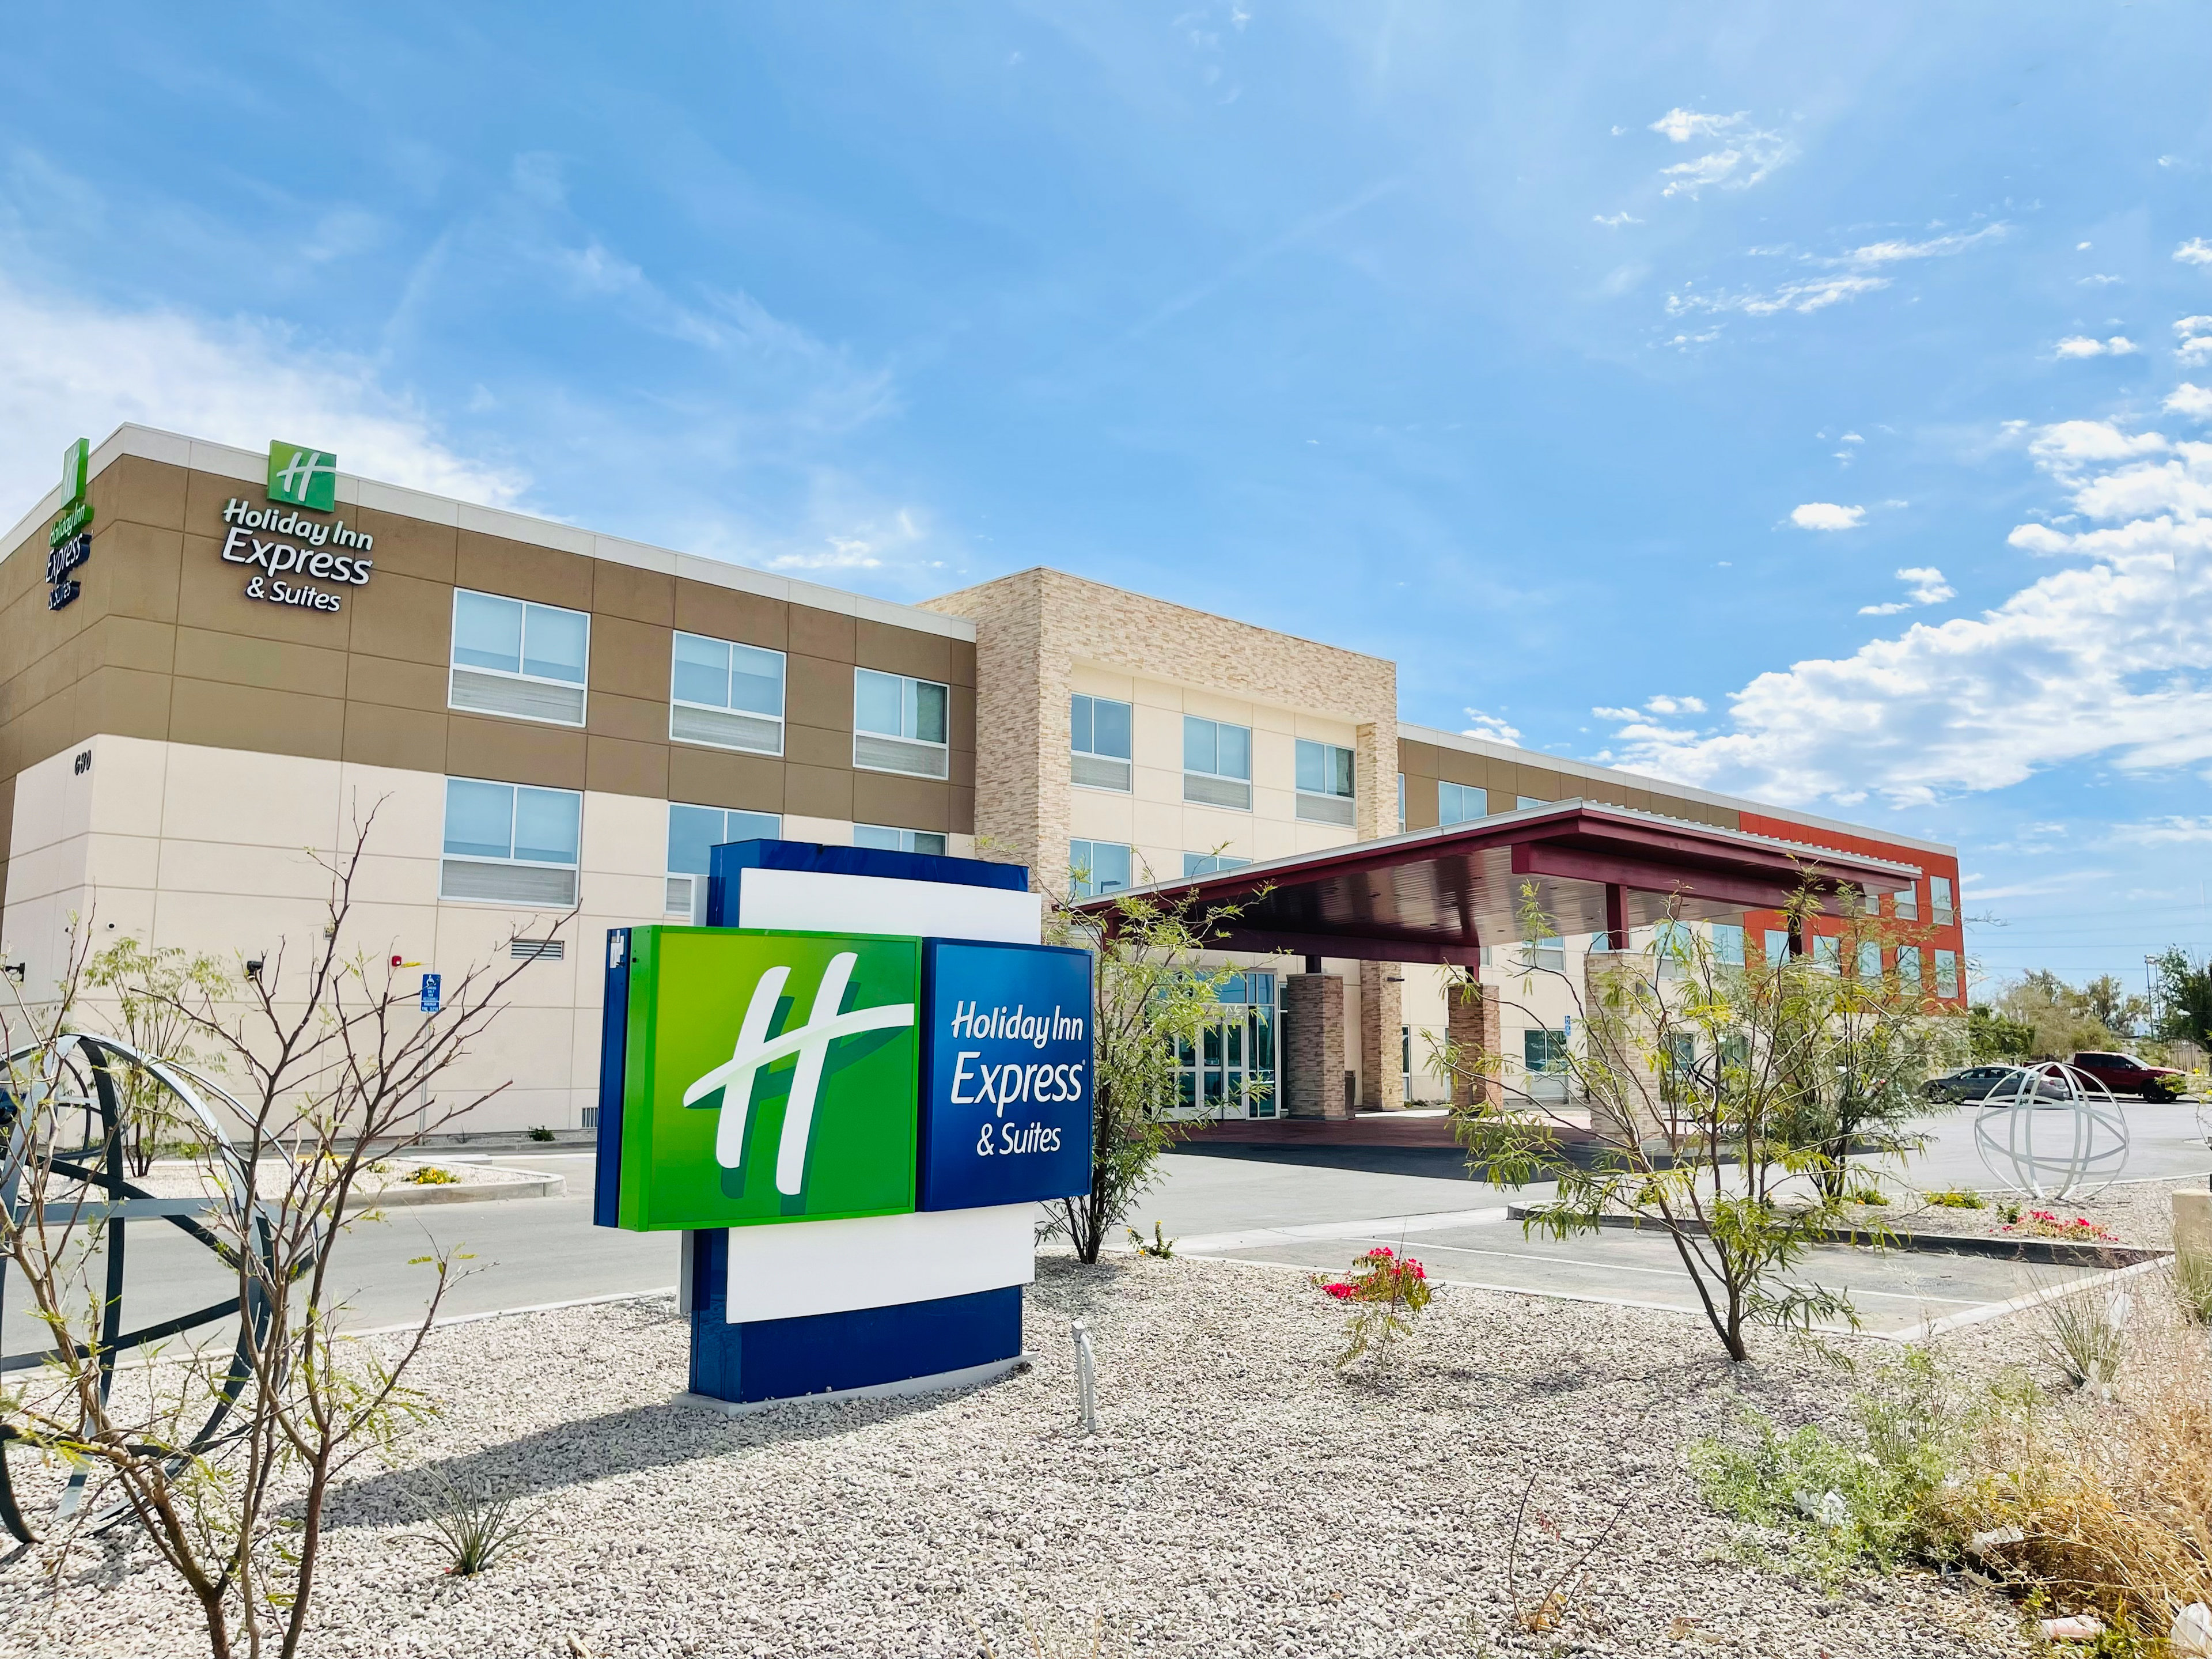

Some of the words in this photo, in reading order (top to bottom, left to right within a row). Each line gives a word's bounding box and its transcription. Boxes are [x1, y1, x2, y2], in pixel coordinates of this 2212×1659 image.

[49, 512, 74, 546] Holiday
[73, 502, 85, 527] Inn
[223, 498, 329, 546] Holiday
[332, 520, 374, 551] Inn
[45, 533, 83, 584] Express
[222, 527, 370, 585] Express
[53, 579, 72, 607] Sues
[247, 576, 265, 598] &
[269, 581, 341, 612] Suites
[74, 749, 91, 775] 630
[950, 1000, 1050, 1049] Holiday
[1052, 1005, 1084, 1041] Inn
[683, 952, 915, 1195] H
[950, 1051, 1084, 1118] Express
[976, 1123, 994, 1157] &
[999, 1122, 1062, 1155] Suites
